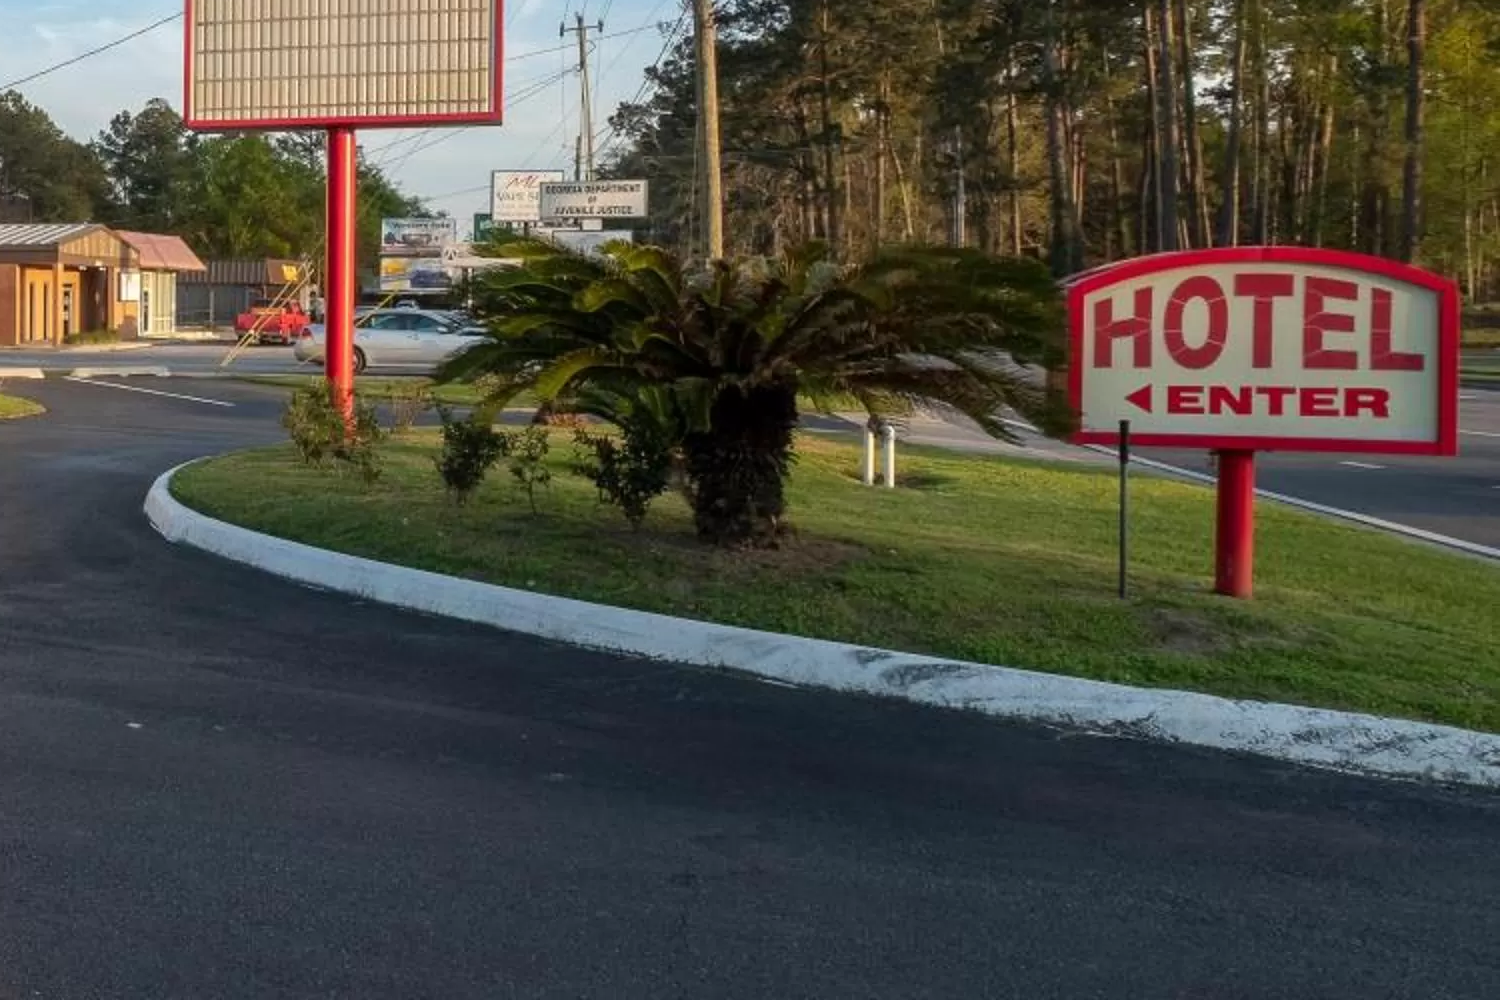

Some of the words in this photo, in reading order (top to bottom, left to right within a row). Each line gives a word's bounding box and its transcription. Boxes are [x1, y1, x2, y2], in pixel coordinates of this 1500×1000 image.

[584, 183, 641, 194] DEPARTMENT
[555, 206, 594, 215] JUVENILE
[596, 205, 633, 215] JUSTICE
[1093, 273, 1425, 371] HOTEL
[1166, 385, 1389, 418] ENTER
